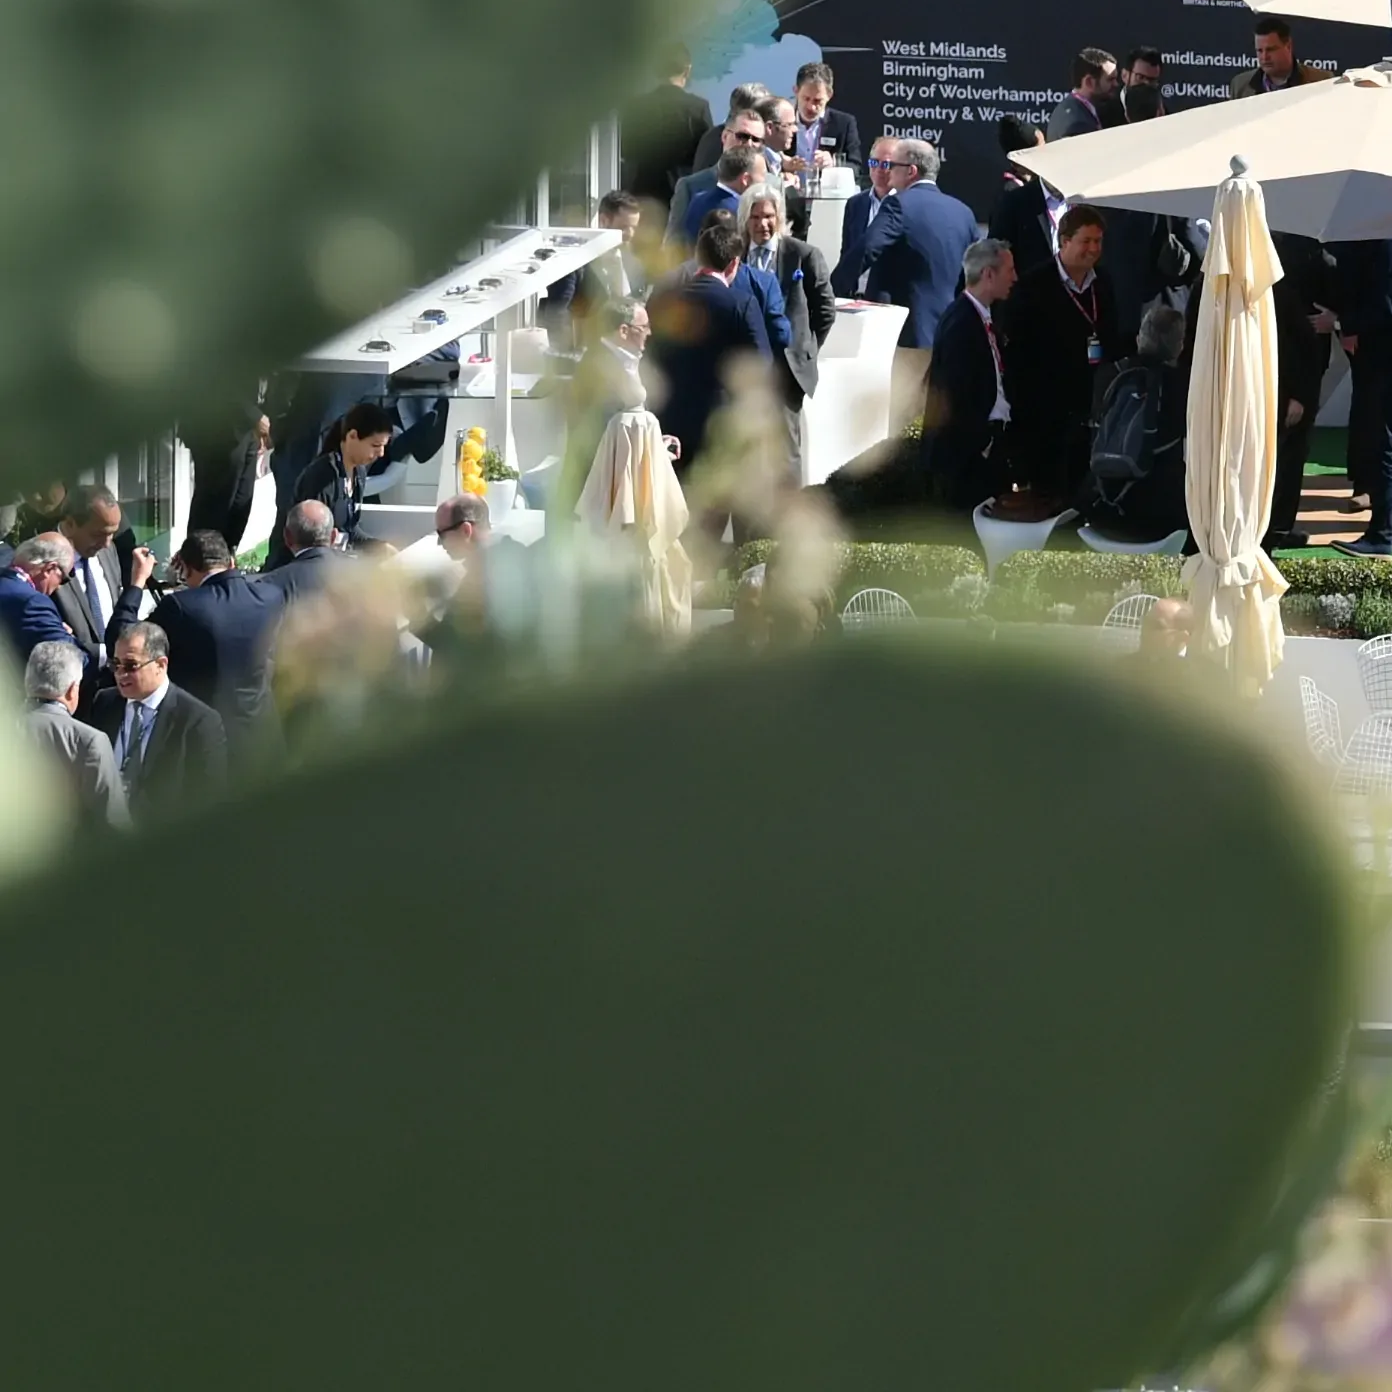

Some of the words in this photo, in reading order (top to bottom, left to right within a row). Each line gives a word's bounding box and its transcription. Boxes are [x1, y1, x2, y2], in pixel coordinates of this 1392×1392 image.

[882, 40, 926, 56] West
[930, 42, 1007, 58] Midlands
[883, 62, 985, 81] Birmingham
[883, 82, 915, 101] City
[919, 84, 937, 97] of
[882, 104, 956, 124] Coventry
[962, 107, 974, 120] &
[883, 124, 943, 144] Dudley
